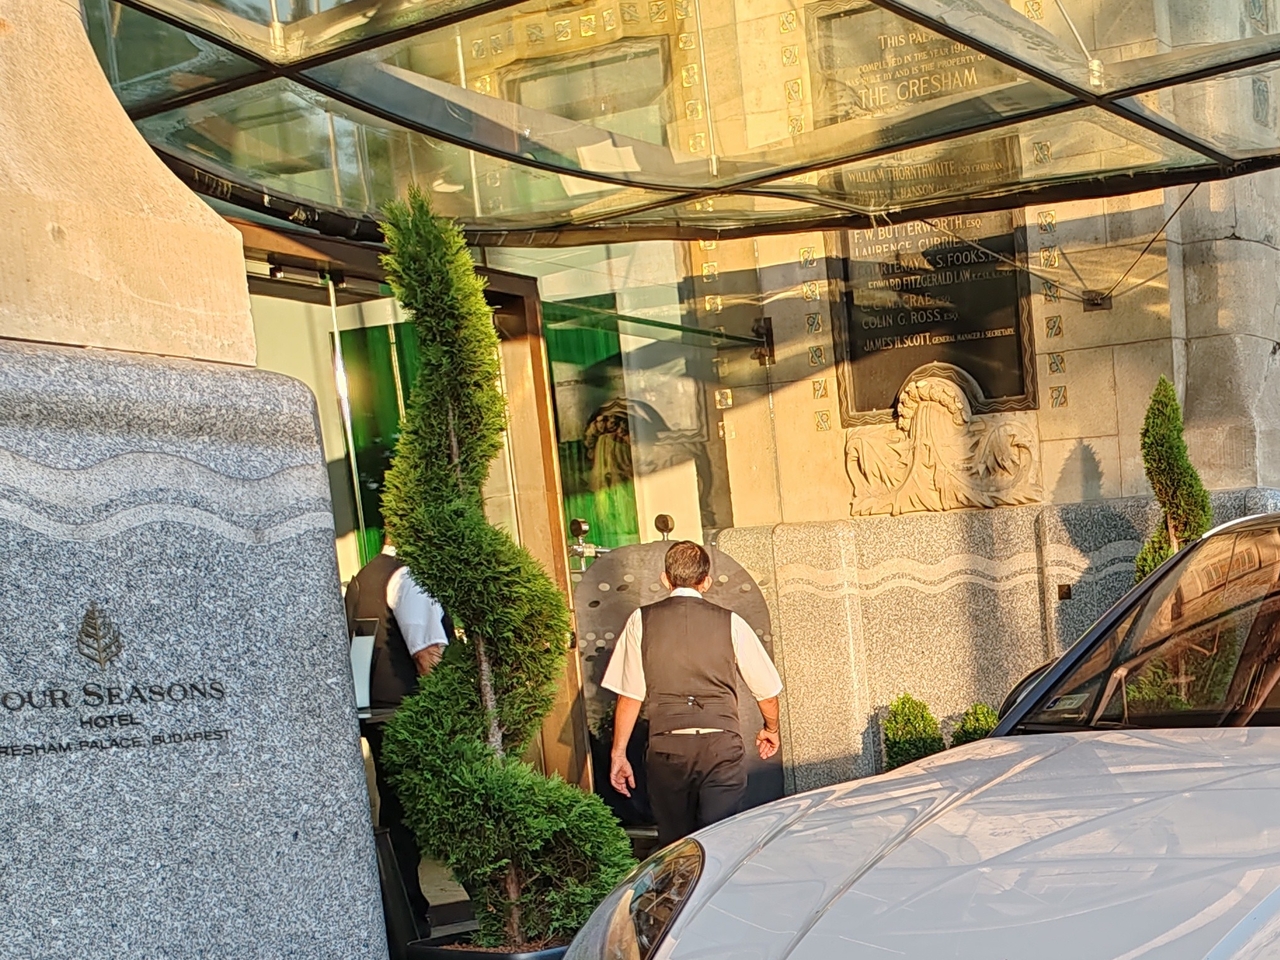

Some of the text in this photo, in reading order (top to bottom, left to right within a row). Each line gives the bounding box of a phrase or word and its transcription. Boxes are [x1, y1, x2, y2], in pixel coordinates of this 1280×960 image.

[878, 33, 906, 50] THIS
[857, 56, 903, 74] COMPLETED
[904, 53, 912, 64] IN
[914, 50, 928, 61] THE
[929, 47, 949, 59] YEAR
[883, 71, 893, 81] BY
[894, 68, 909, 79] AND
[911, 66, 919, 74] IS
[920, 63, 935, 73] THE
[937, 55, 975, 69] PROPERTY
[977, 53, 987, 61] OF
[858, 66, 978, 109] THE GRESHAM
[848, 169, 884, 183] WILLIAM
[885, 160, 956, 181] THORNTHWAITE
[854, 231, 863, 243] F.
[864, 229, 876, 241] W.
[854, 240, 911, 257] LAURENCE
[936, 255, 946, 268] S.
[902, 273, 953, 291] FITZGERALD
[862, 315, 893, 330] COLIN
[897, 313, 907, 326] G.
[864, 337, 893, 352] JAMES
[932, 335, 955, 344] GENERAL
[956, 331, 981, 341] MANAGER
[0, 682, 225, 712] OUR SEASONS
[79, 714, 141, 729] HOTEL
[0, 742, 72, 756] RESHAM
[151, 729, 232, 746] BUDAPEST
